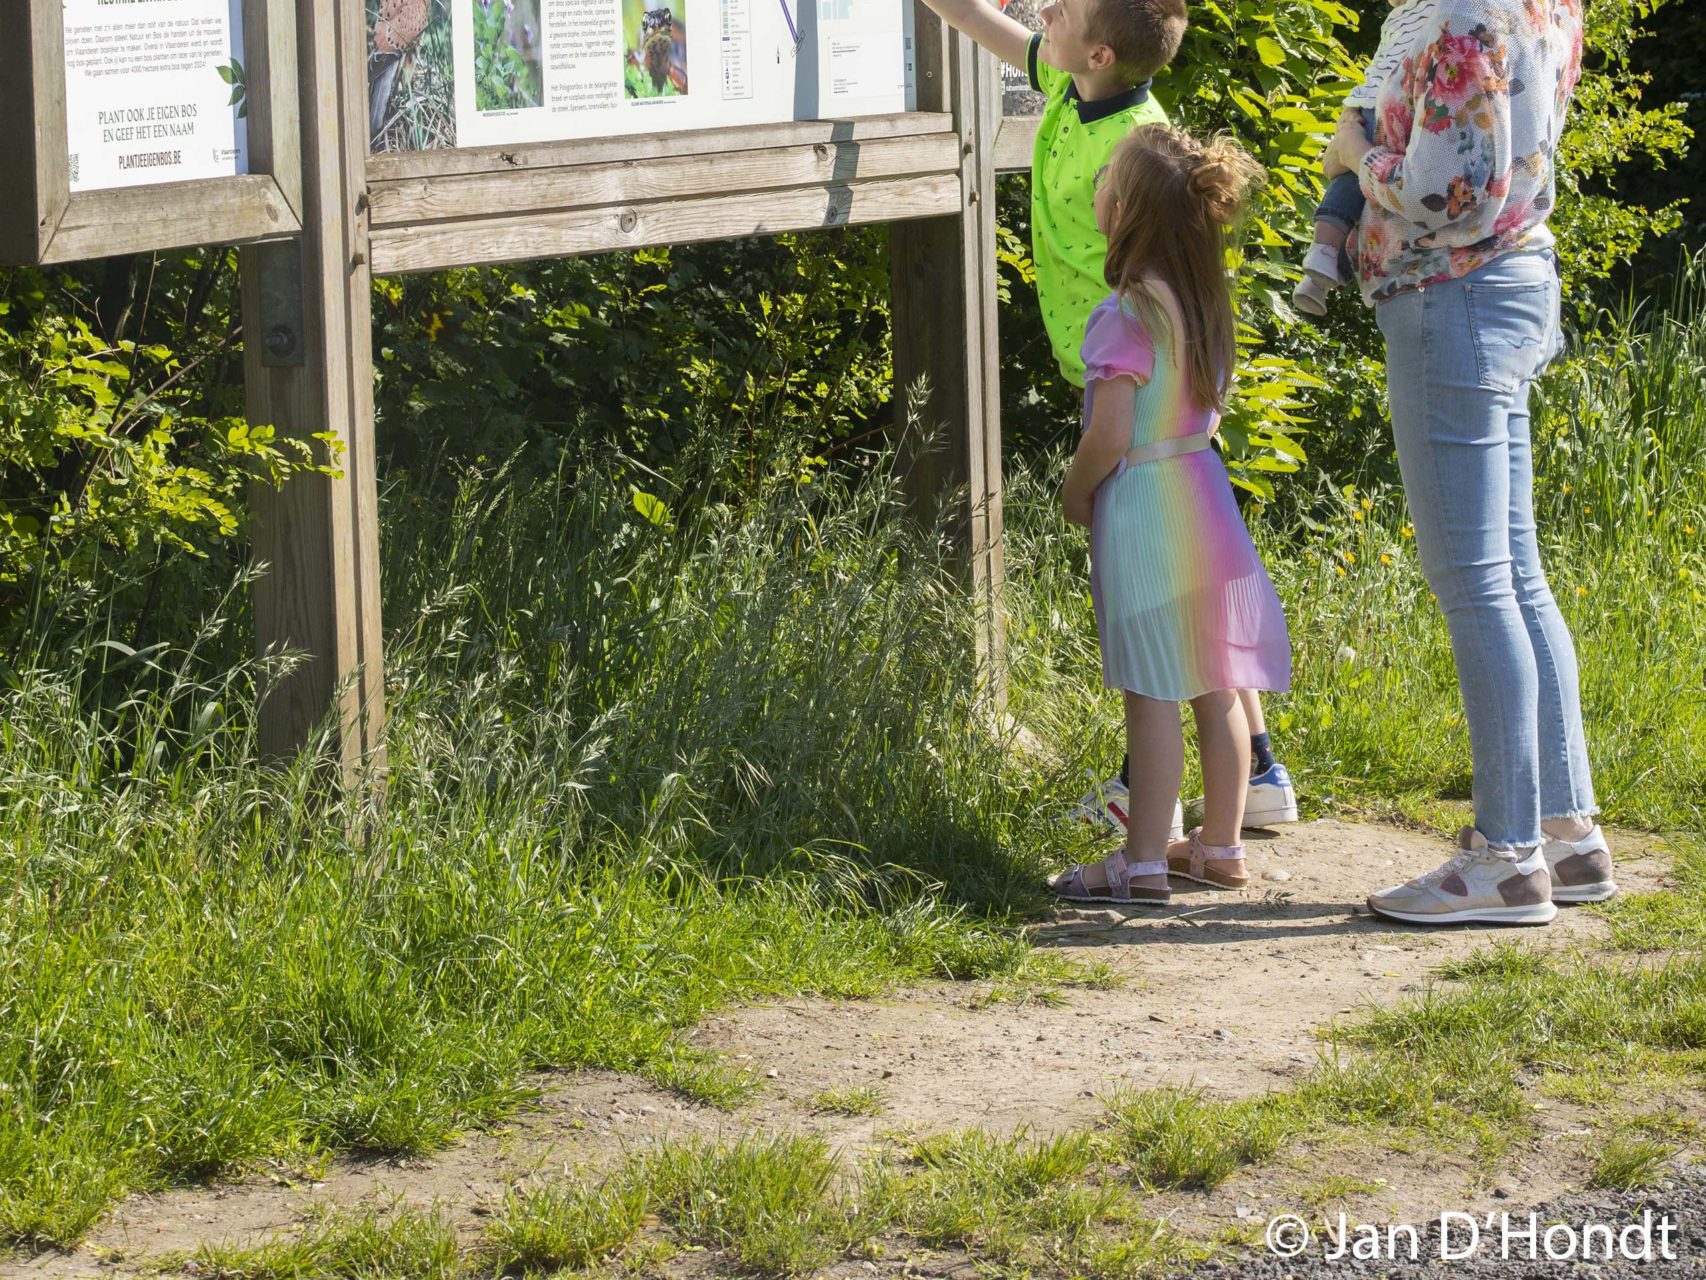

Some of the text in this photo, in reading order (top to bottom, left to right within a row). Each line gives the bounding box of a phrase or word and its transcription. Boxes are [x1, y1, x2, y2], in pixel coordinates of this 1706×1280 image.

[99, 104, 197, 125] PLANT OOK JE EIGEN BOS
[104, 122, 194, 143] EN GEEF HET EEN NAAM
[119, 150, 182, 170] PLANTJEEIGENBOS.BE
